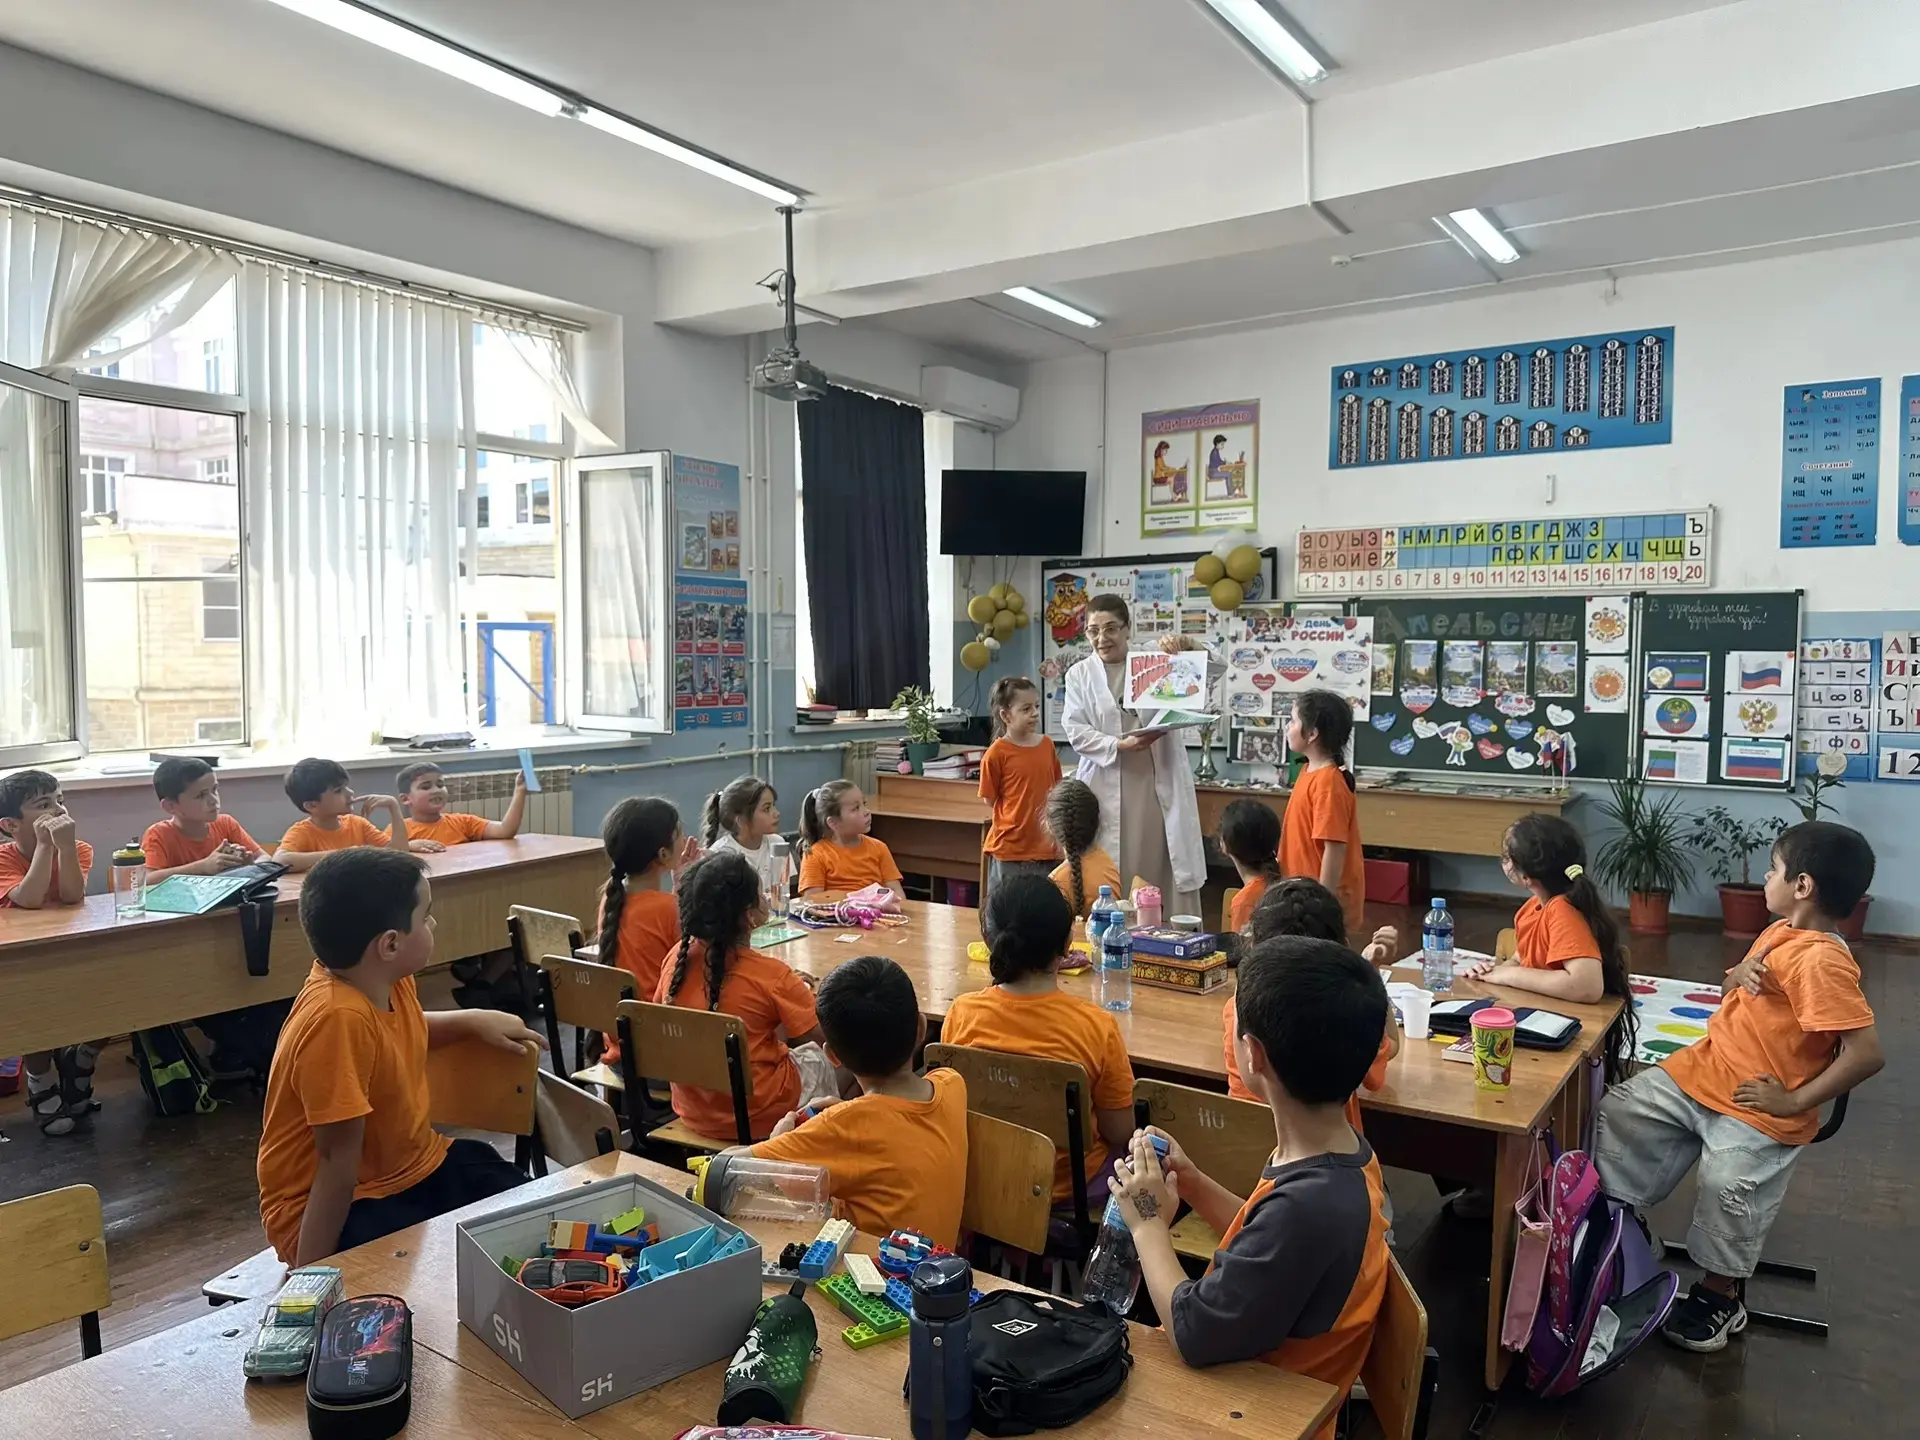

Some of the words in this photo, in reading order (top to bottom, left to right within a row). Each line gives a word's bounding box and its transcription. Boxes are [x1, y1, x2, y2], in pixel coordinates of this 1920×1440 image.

[1304, 578, 1310, 588] 1
[1321, 577, 1328, 588] 2
[1339, 576, 1346, 587] 3
[1357, 575, 1364, 586] 4
[1375, 574, 1383, 586] 5
[1395, 574, 1402, 586] 6
[1414, 573, 1422, 585] 7
[1433, 573, 1441, 585] 8
[1452, 572, 1461, 585] 9
[1470, 572, 1484, 584] 10
[1490, 571, 1503, 584] 11
[1510, 570, 1524, 583] 12
[1531, 569, 1546, 582] 13
[1552, 568, 1567, 581] 14
[1573, 568, 1589, 581] 15
[1595, 568, 1611, 581] 16
[1617, 567, 1632, 580] 17
[1640, 566, 1655, 580] 18
[1662, 566, 1677, 579] 19
[1686, 565, 1702, 578] 20
[1291, 630, 1344, 641] РОССИИ
[1885, 637, 1904, 654] А
[1886, 660, 1906, 676] И
[1853, 688, 1862, 703] 8
[1883, 683, 1908, 701] С
[1887, 709, 1904, 726] Ъ
[1885, 751, 1899, 774] 1
